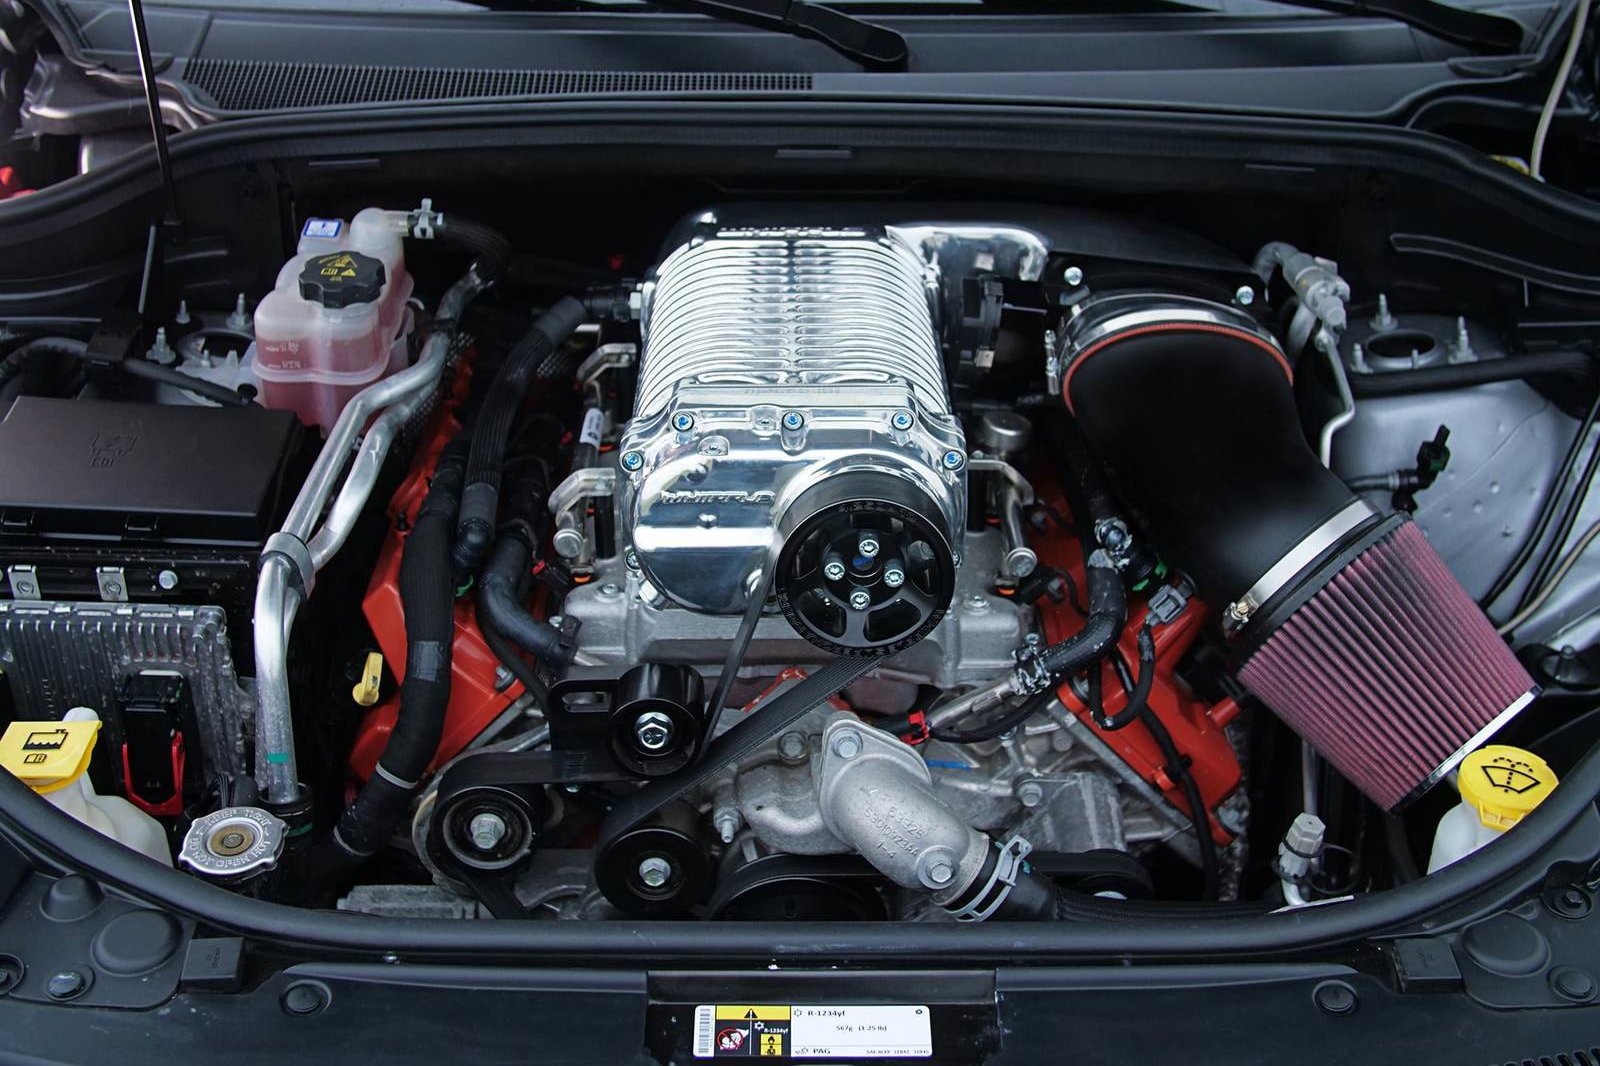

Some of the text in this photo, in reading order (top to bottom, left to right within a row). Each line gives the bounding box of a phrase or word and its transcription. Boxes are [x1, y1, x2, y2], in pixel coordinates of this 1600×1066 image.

[206, 809, 272, 827] KEEP TIGHT
[215, 857, 251, 868] OPEN
[807, 1010, 846, 1018] R-1234yf
